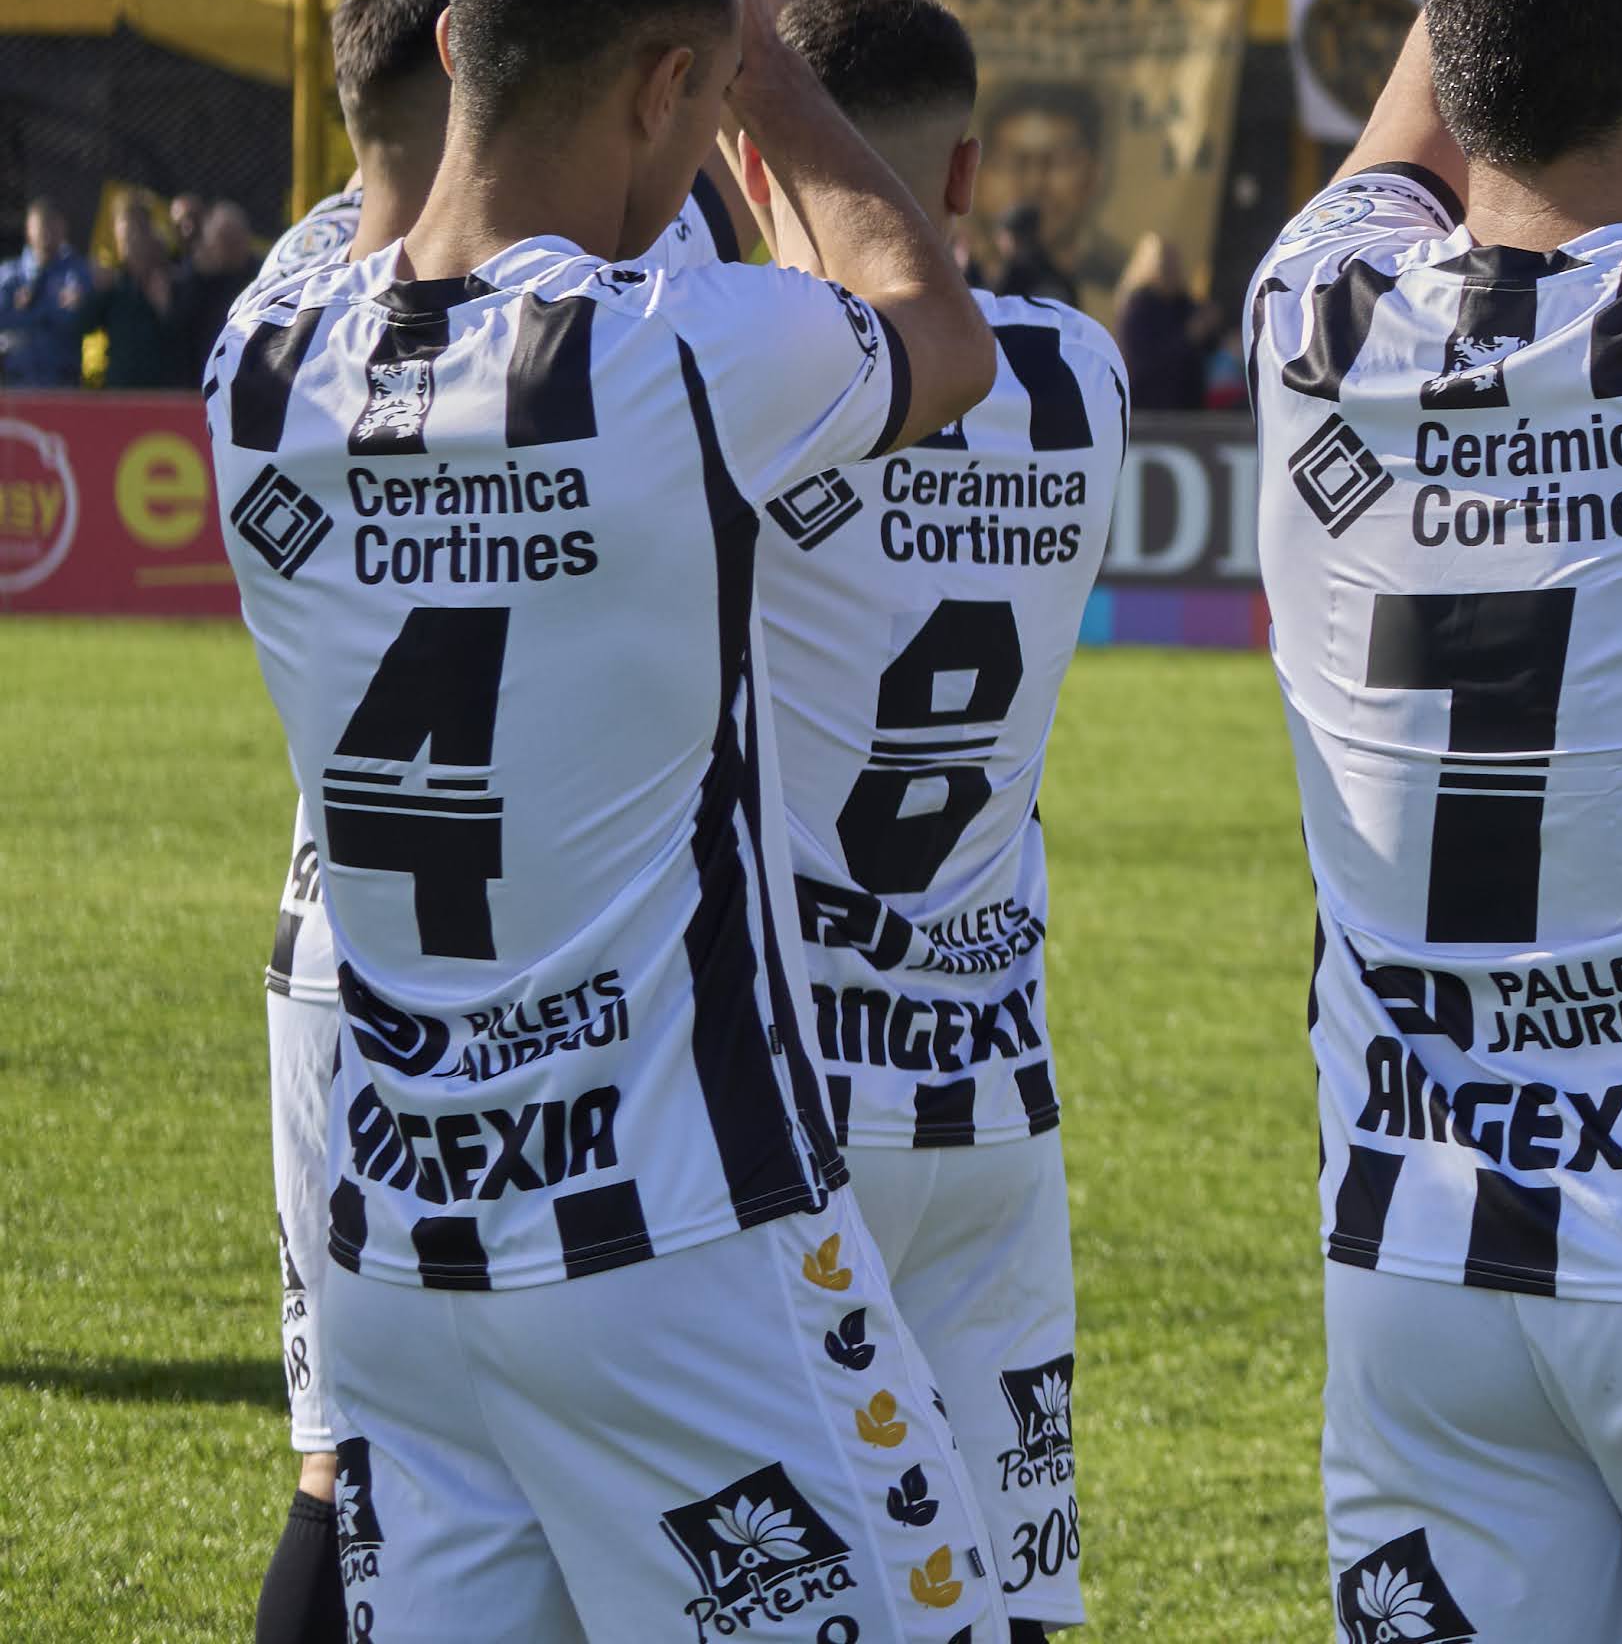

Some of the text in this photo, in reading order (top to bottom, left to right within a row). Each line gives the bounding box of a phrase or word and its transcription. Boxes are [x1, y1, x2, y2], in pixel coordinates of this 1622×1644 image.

[347, 461, 590, 518] Cerámica
[881, 459, 1087, 510] Cerámica
[354, 522, 599, 586] Cortines
[880, 510, 1082, 566] Cortines
[322, 606, 512, 961] 4
[835, 600, 1024, 894] 8
[1366, 586, 1577, 943] 7
[811, 979, 1042, 1073] ANGEXI
[1027, 1411, 1058, 1447] La
[710, 1545, 770, 1588] La
[1002, 1494, 1080, 1594] 308
[684, 1561, 858, 1644] Porteña
